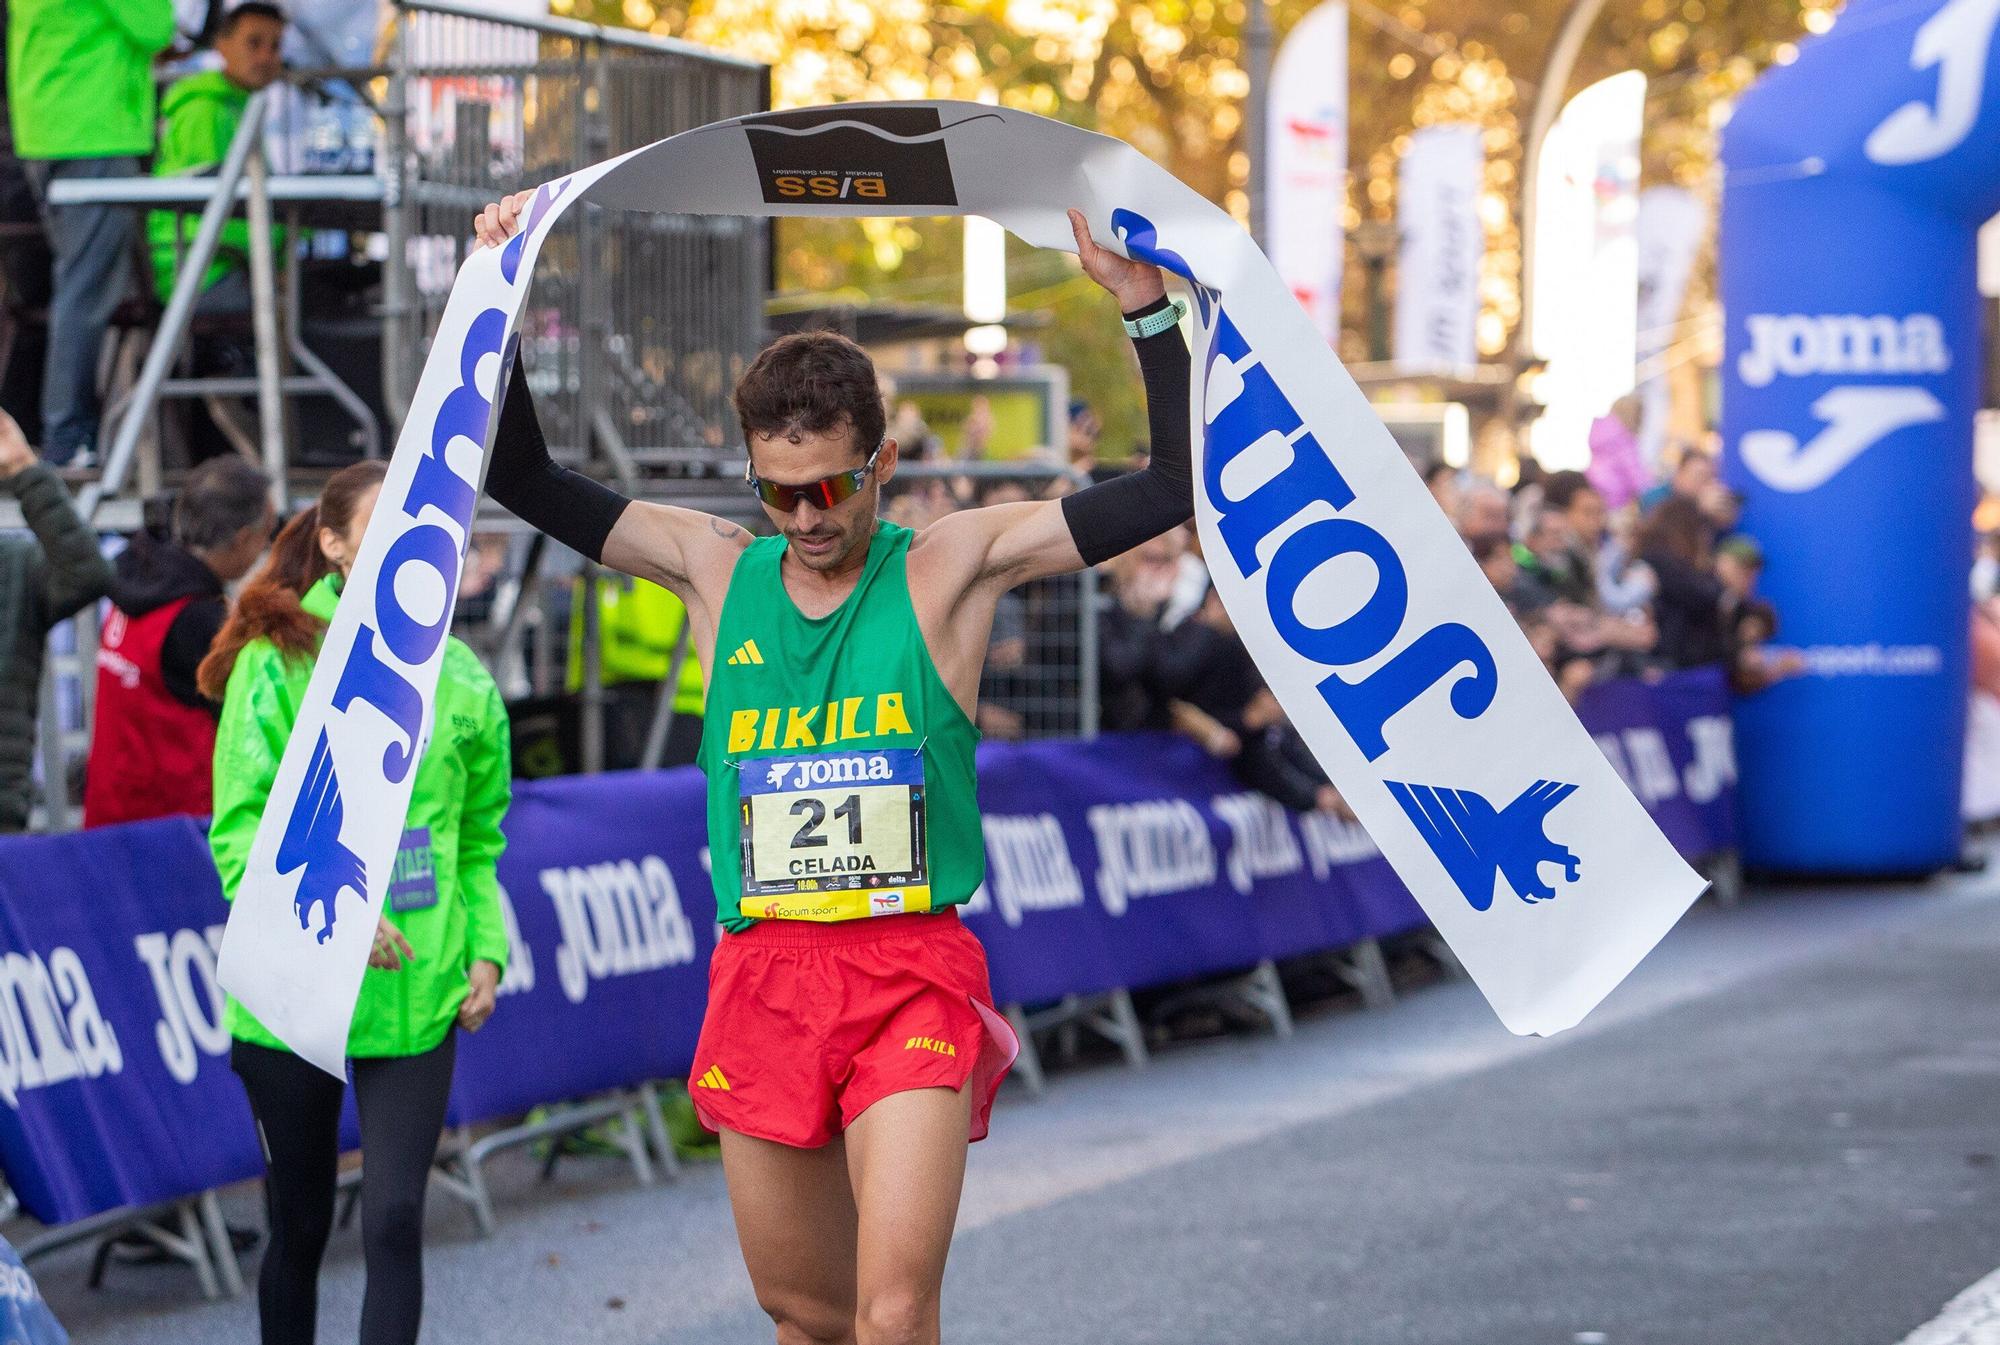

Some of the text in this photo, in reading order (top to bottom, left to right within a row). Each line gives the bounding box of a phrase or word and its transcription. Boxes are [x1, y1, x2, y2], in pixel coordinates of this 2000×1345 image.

[775, 177, 887, 199] B/SS
[727, 692, 913, 753] BIKILA
[742, 804, 750, 826] 1
[789, 794, 863, 849] 21
[789, 855, 876, 876] CELADA
[812, 906, 838, 916] sport
[904, 1036, 956, 1057] BIKILA
